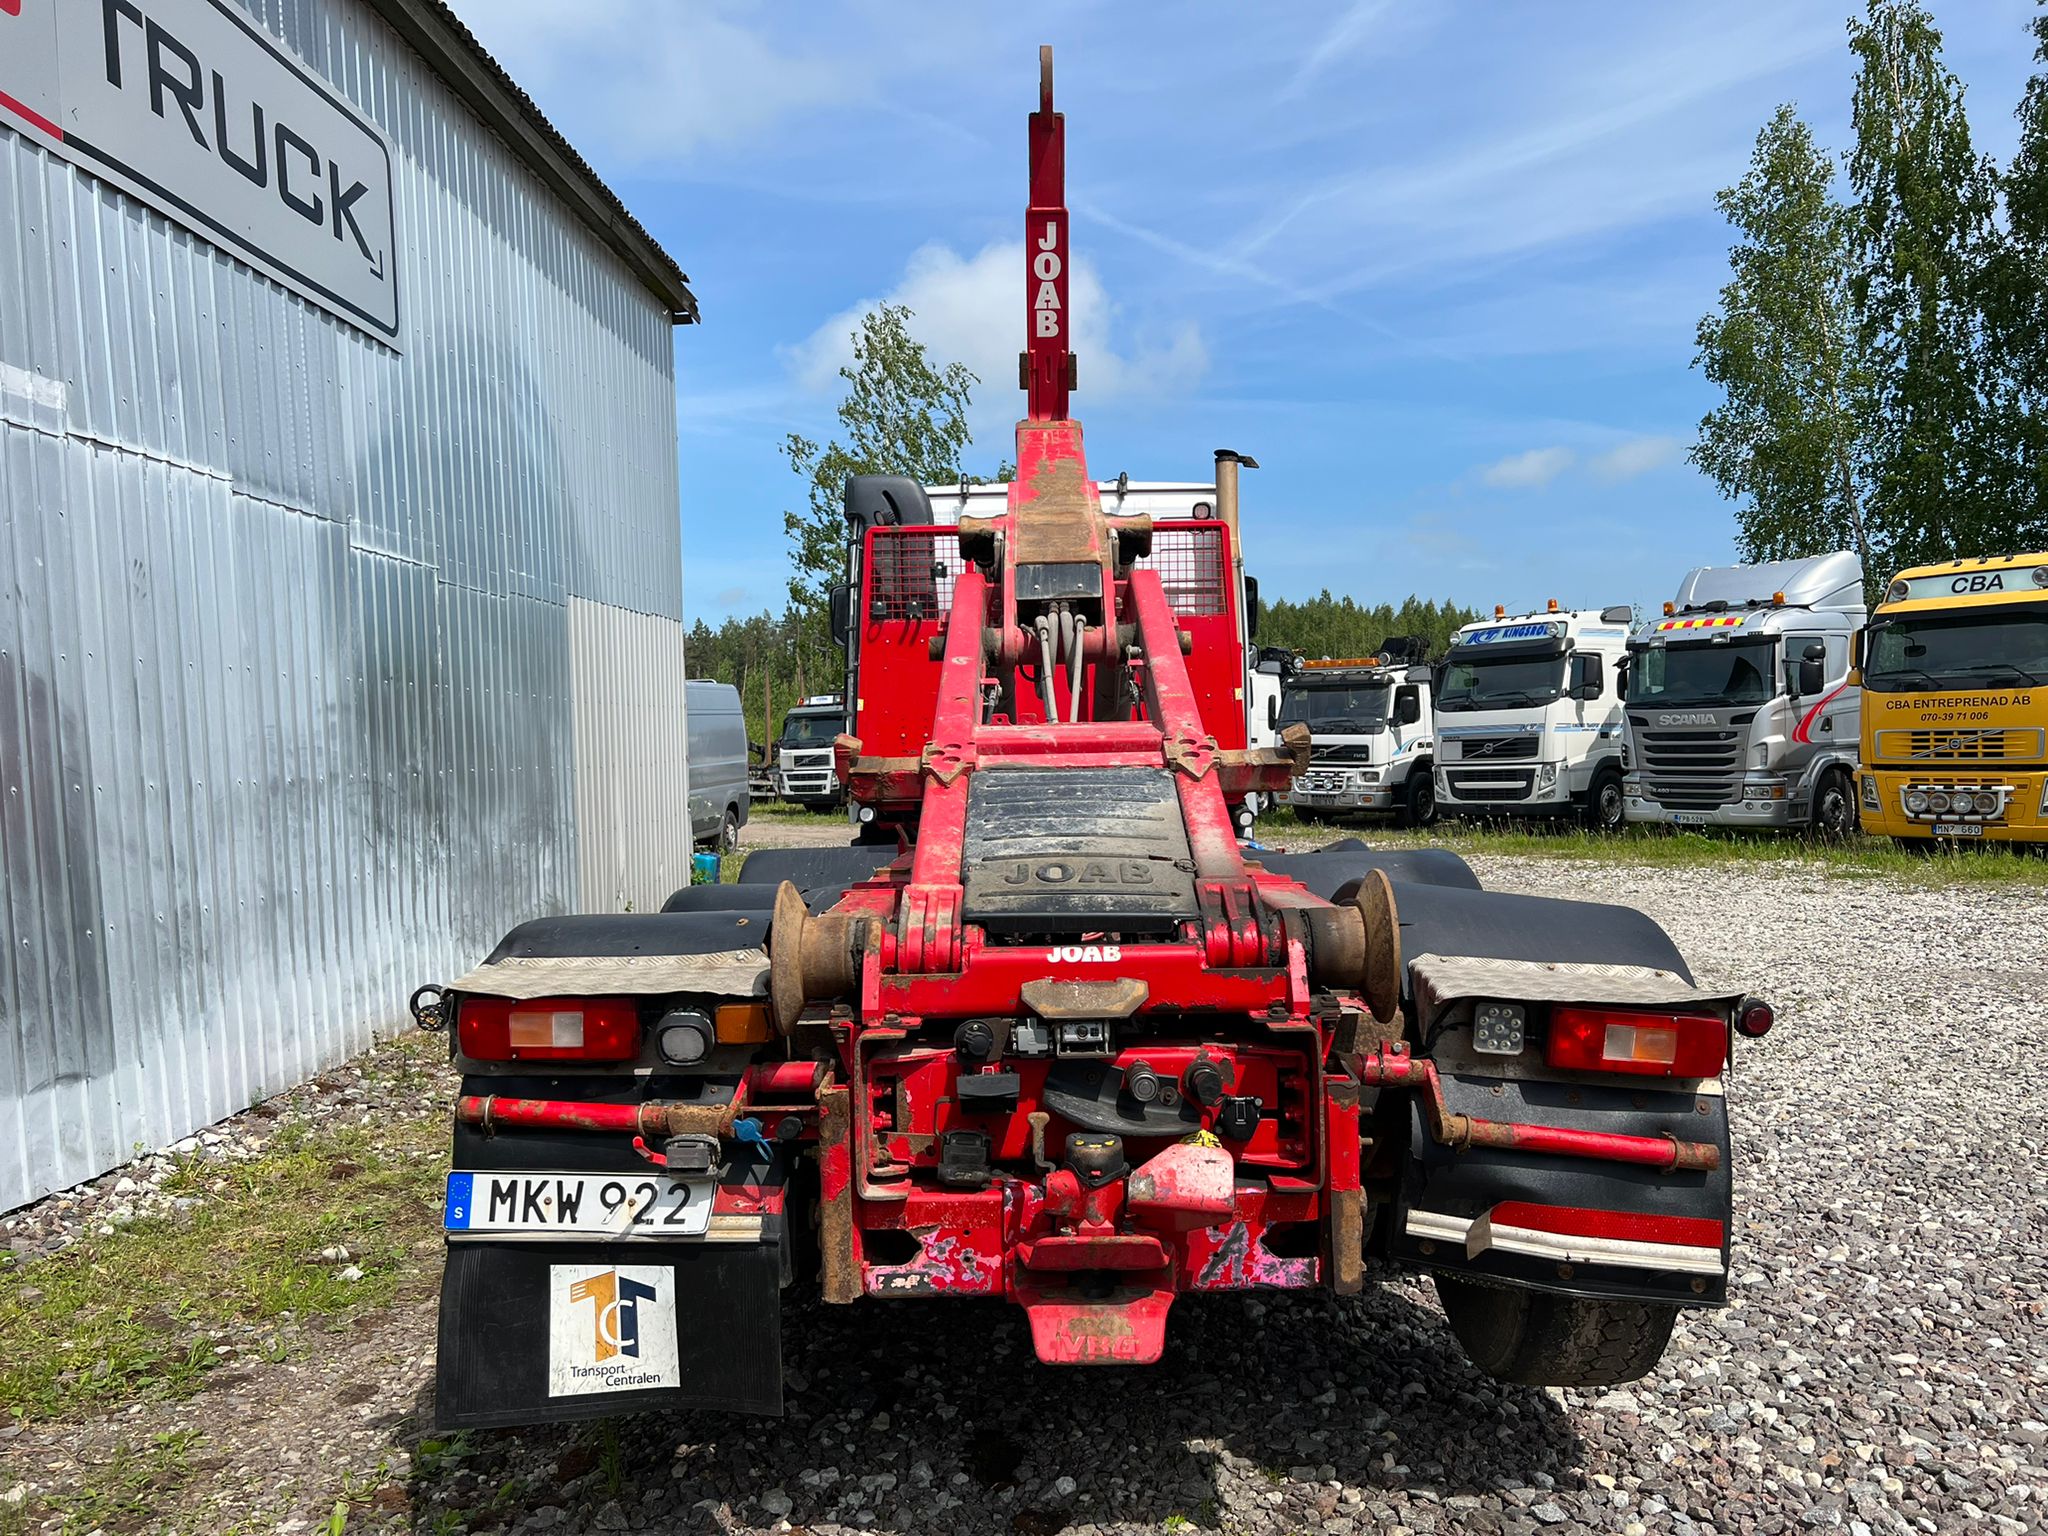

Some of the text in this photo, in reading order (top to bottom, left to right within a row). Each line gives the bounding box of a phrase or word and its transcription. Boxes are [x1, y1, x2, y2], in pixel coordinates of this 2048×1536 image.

[102, 0, 376, 264] TRUCK
[1033, 221, 1062, 338] JOAB
[1951, 573, 2004, 594] CBA
[1886, 695, 2031, 710] CBA ENTREPRENAD AB
[1658, 713, 1717, 726] SCANIA
[1920, 711, 1989, 722] 070-39 71 006
[1961, 825, 1980, 834] 660
[1004, 862, 1154, 884] JOAB
[1046, 946, 1122, 963] JOAB
[488, 1179, 584, 1224] MKW
[600, 1182, 691, 1225] 922
[570, 1364, 625, 1378] Transport
[605, 1373, 661, 1387] Centralen
